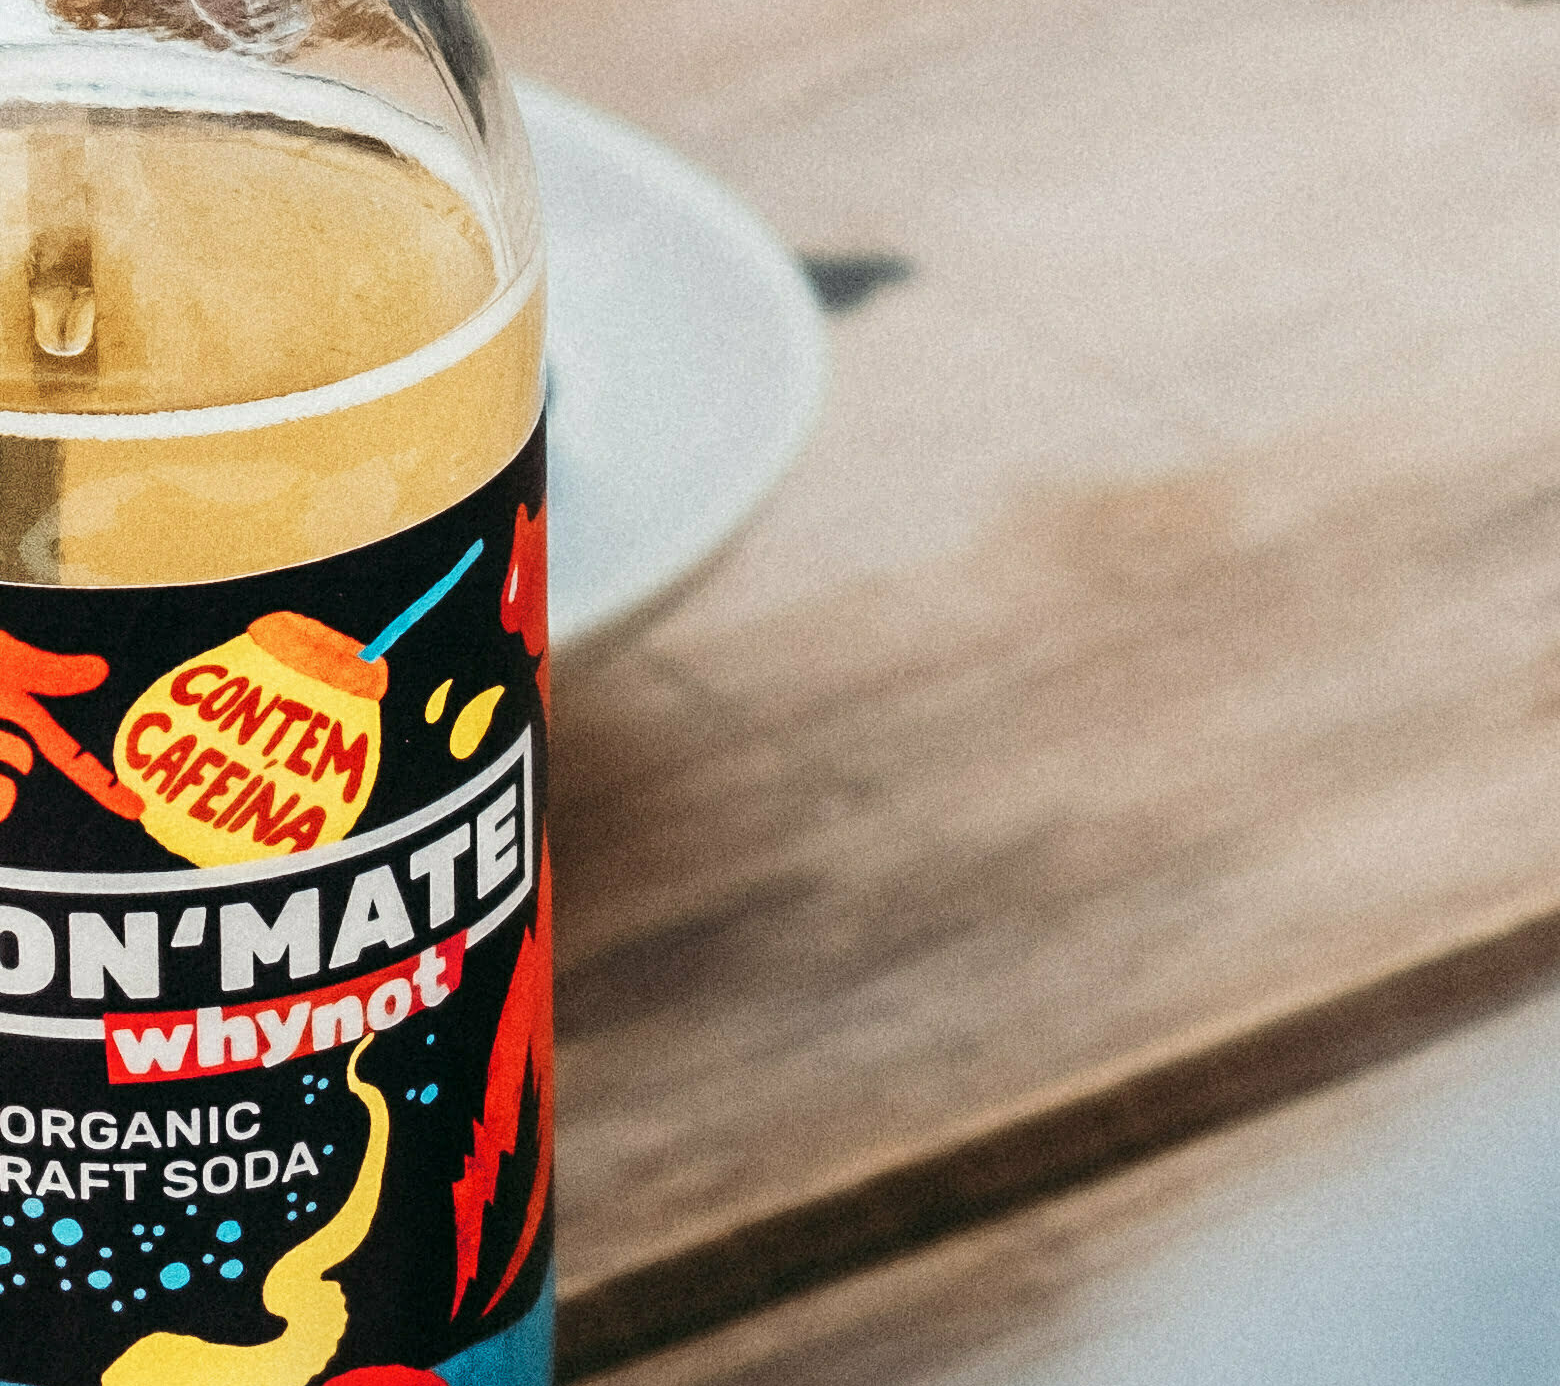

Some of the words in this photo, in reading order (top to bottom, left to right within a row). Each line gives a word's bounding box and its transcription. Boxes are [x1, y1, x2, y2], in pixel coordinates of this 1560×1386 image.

[169, 664, 369, 803] CONTEM
[113, 946, 451, 1073] whynot
[163, 1142, 320, 1199] SODA
